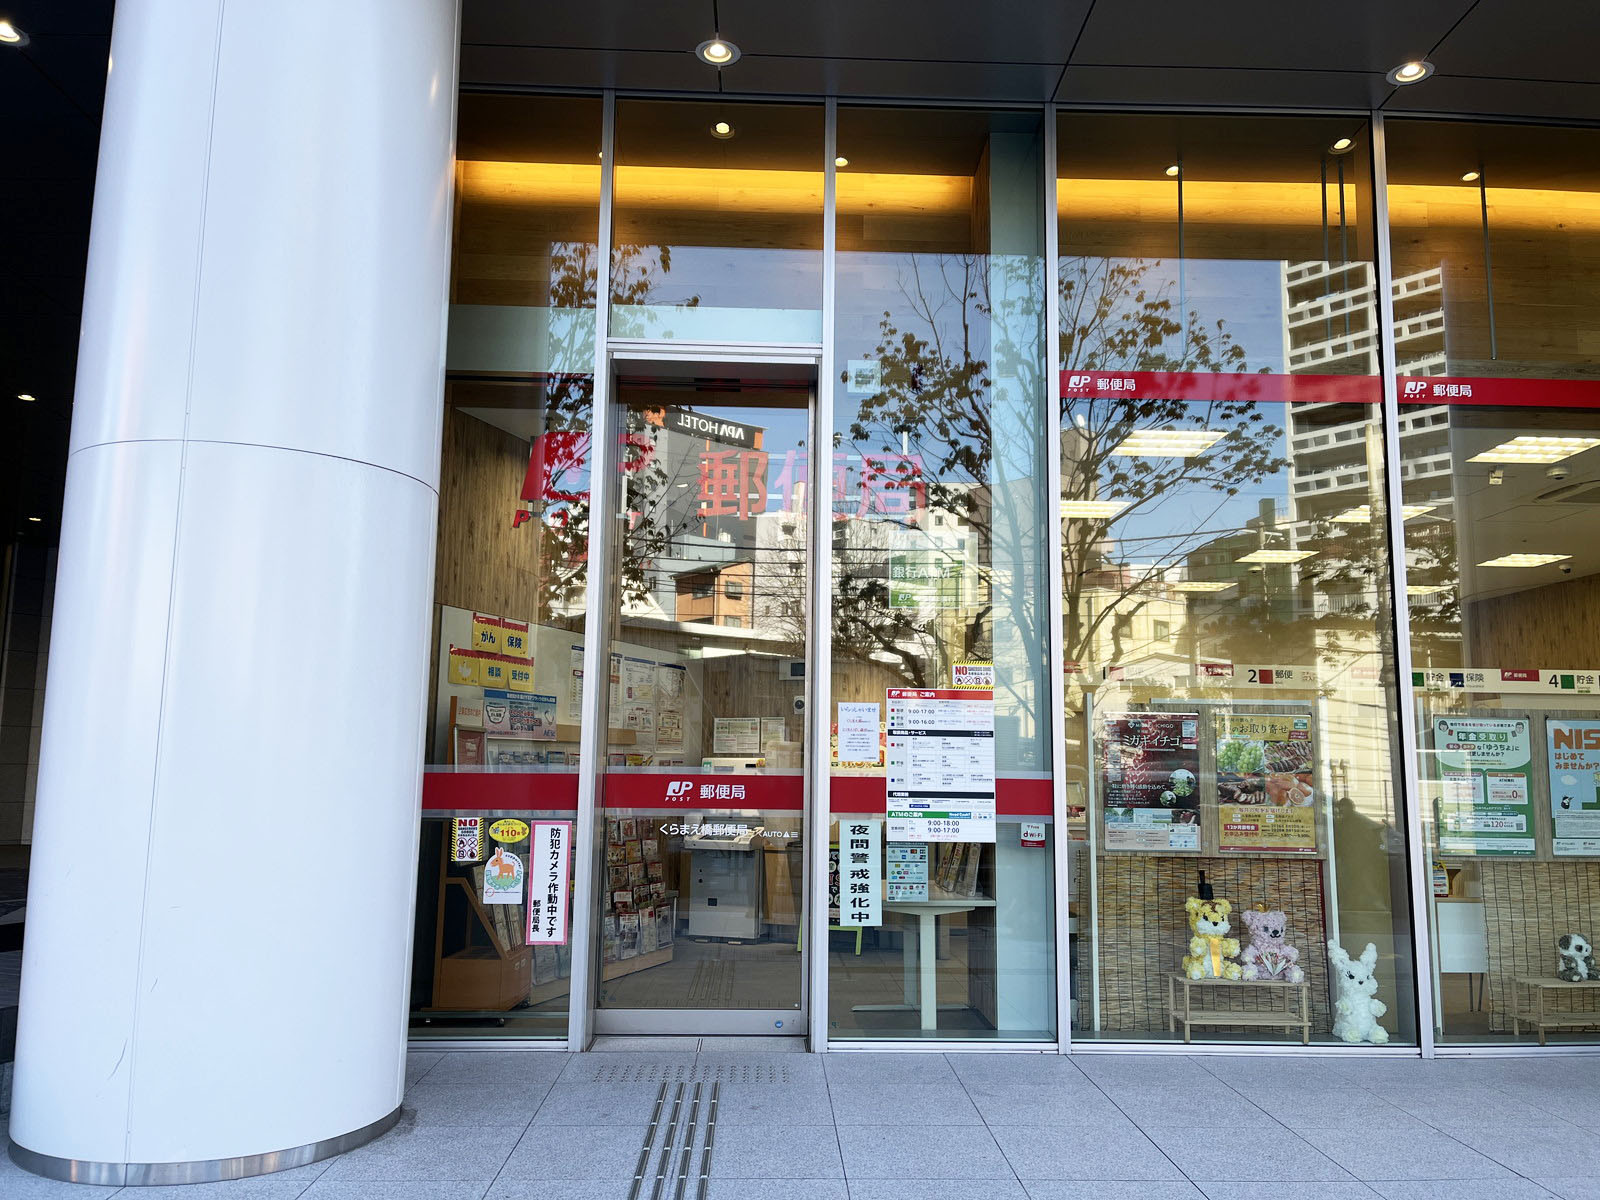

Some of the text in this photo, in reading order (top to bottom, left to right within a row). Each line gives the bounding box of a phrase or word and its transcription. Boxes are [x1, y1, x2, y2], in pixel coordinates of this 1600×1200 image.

[1096, 378, 1136, 391] 郵便局
[1432, 384, 1473, 397] 郵便局
[892, 565, 951, 579] 銀行AM
[480, 630, 496, 644] がん
[507, 635, 523, 649] 保険
[488, 665, 502, 678] 相談
[511, 669, 530, 682] 受付中
[955, 665, 967, 676] NO
[1247, 669, 1257, 683] 2
[1275, 669, 1293, 679] 郵便
[1466, 673, 1485, 682] 保険
[1548, 674, 1594, 688] 4 貯金
[1123, 734, 1181, 749] ミガキイチゴ
[1458, 732, 1506, 741] 年金受取り
[1554, 752, 1584, 760] はじめて
[699, 784, 746, 800] 郵便局
[458, 819, 478, 827] NO
[659, 823, 748, 836] くらまえ橋郵便局
[850, 824, 870, 923] 夜間警戒強化中
[546, 828, 562, 938] 防犯カメラ作動中です
[531, 899, 541, 933] 郵便局長
